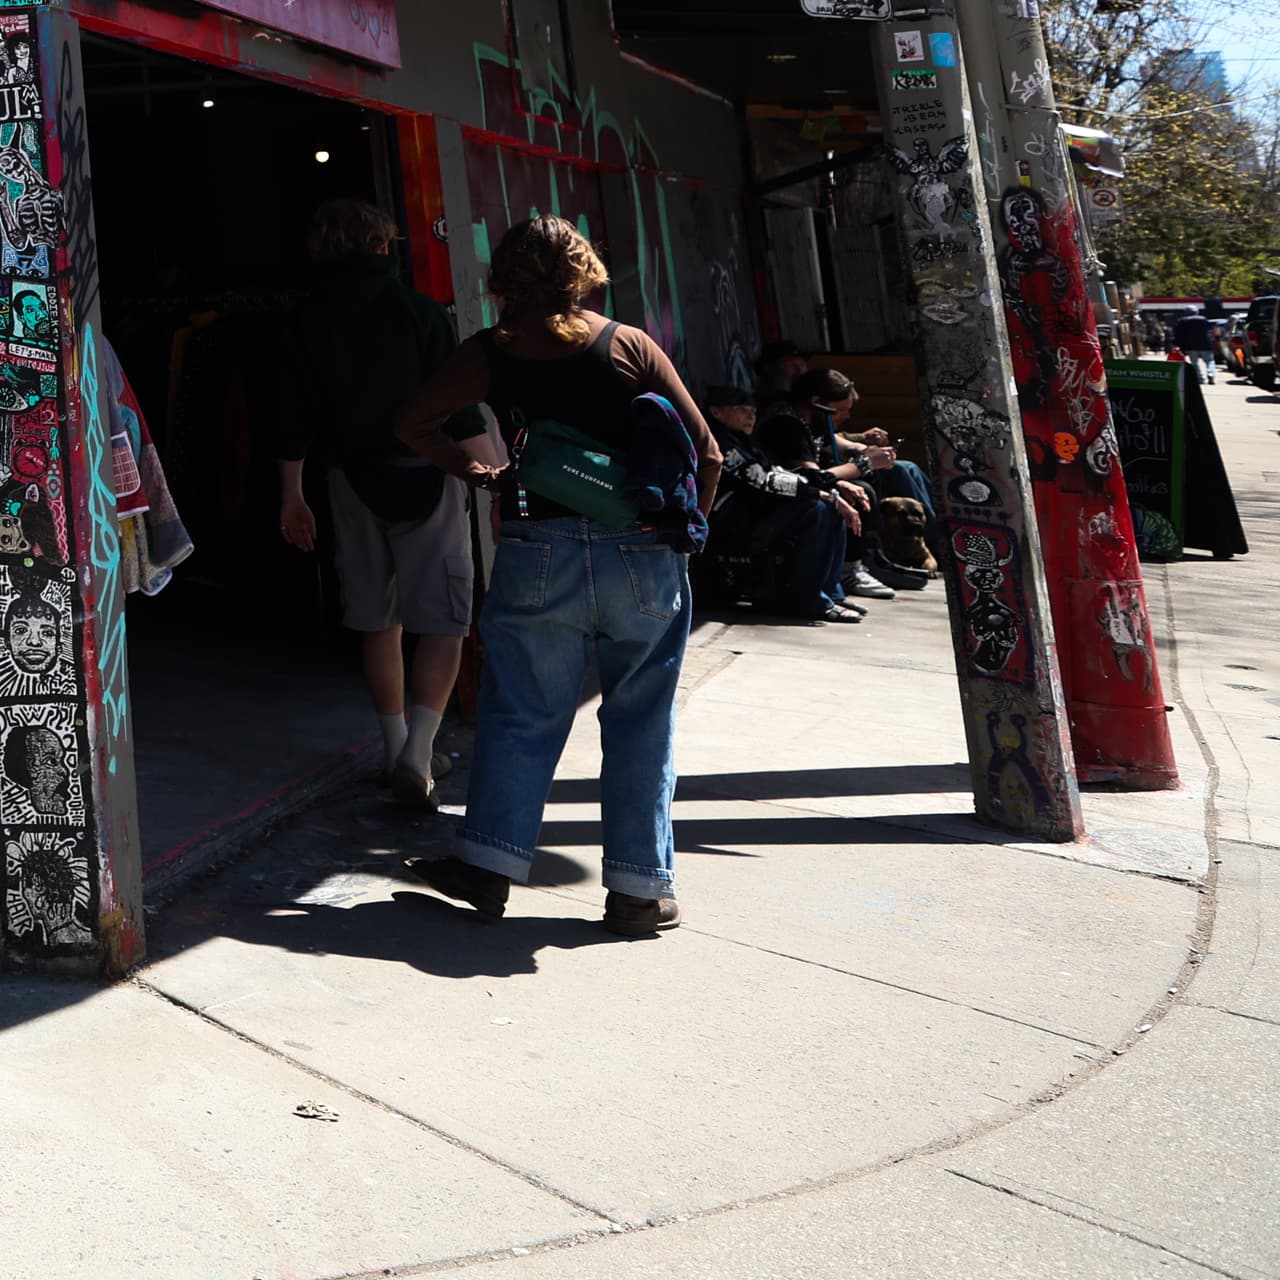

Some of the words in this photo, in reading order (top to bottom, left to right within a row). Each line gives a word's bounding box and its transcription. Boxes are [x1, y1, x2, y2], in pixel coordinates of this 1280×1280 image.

[1130, 369, 1171, 379] WHISTLE
[562, 464, 580, 477] PURE
[580, 472, 614, 491] SUNFARMS
